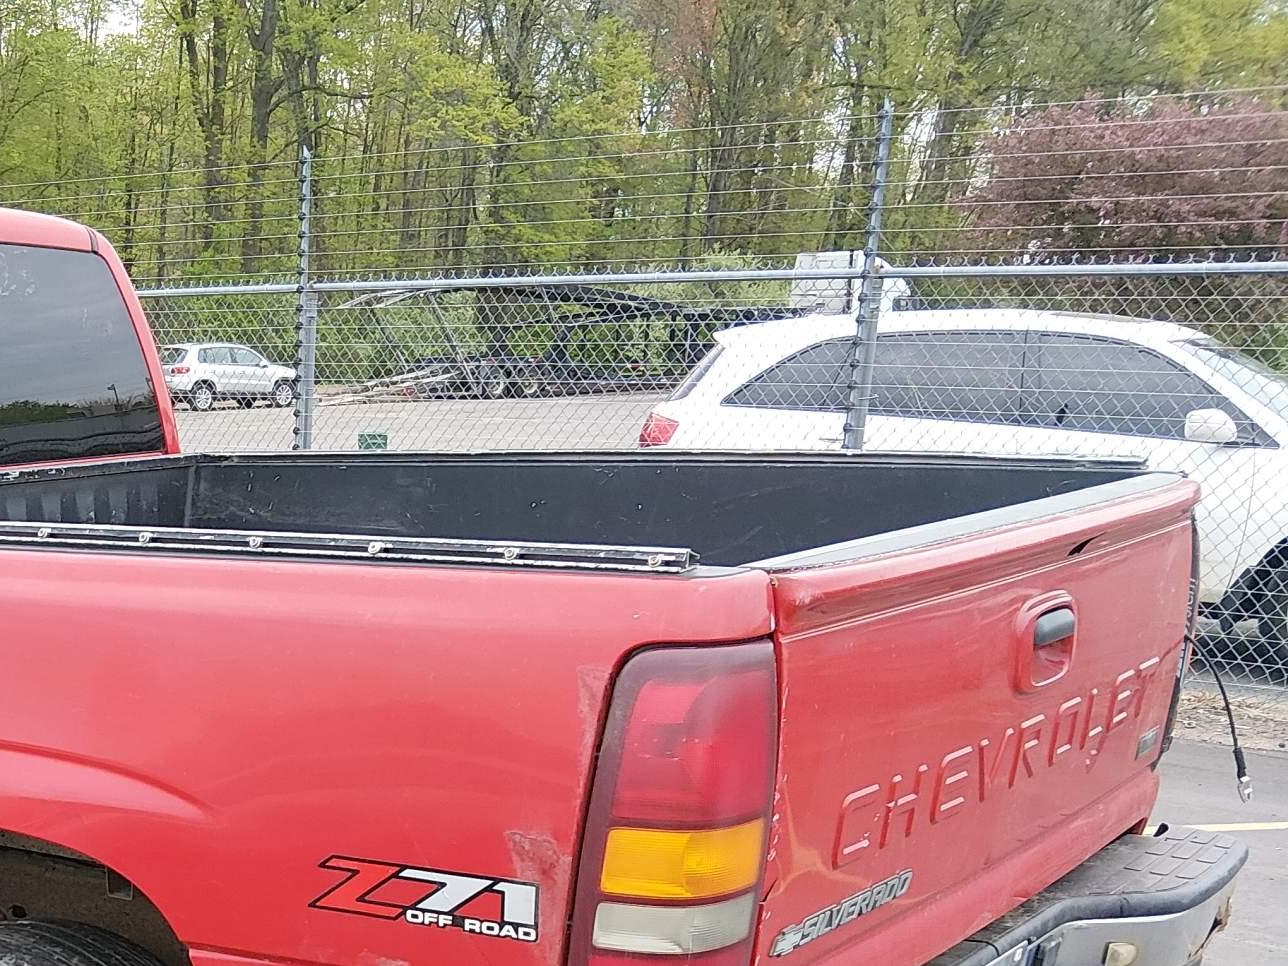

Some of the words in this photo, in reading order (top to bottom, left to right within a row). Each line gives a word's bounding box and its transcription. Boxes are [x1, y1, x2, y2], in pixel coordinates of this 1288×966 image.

[831, 656, 1160, 870] CHEVROLET
[308, 854, 539, 925] Z71
[405, 909, 453, 927] OFF
[464, 918, 537, 941] ROAD
[799, 868, 912, 945] SILVERADO
